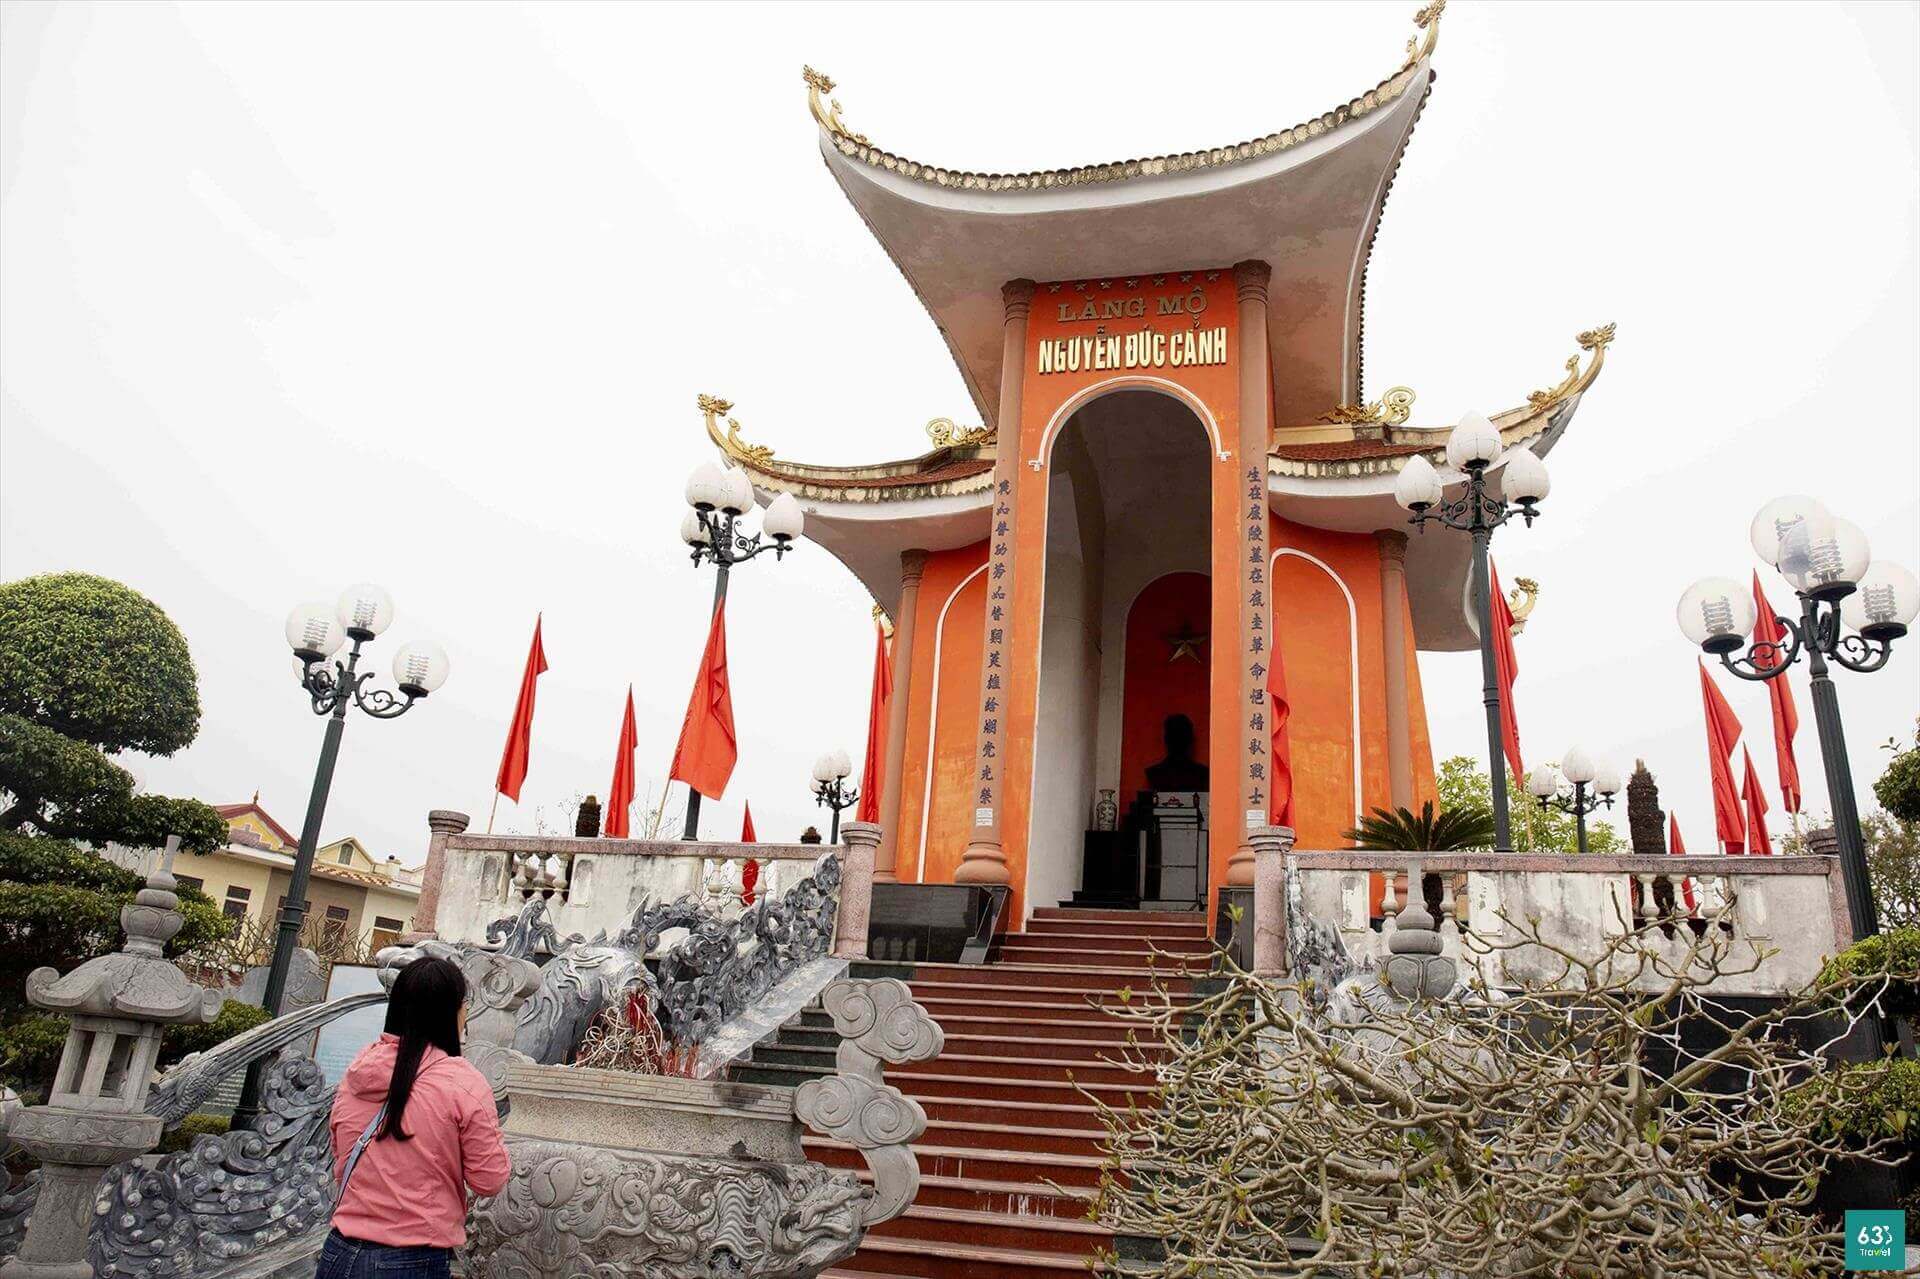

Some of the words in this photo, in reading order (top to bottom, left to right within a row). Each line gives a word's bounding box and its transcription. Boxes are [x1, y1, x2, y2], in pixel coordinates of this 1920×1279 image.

[1057, 294, 1146, 322] LĂNG
[1156, 285, 1208, 319] MỘ
[1038, 327, 1121, 375] NGUYỄN
[1125, 323, 1167, 369] ĐỨC
[1170, 319, 1228, 367] CẢNH
